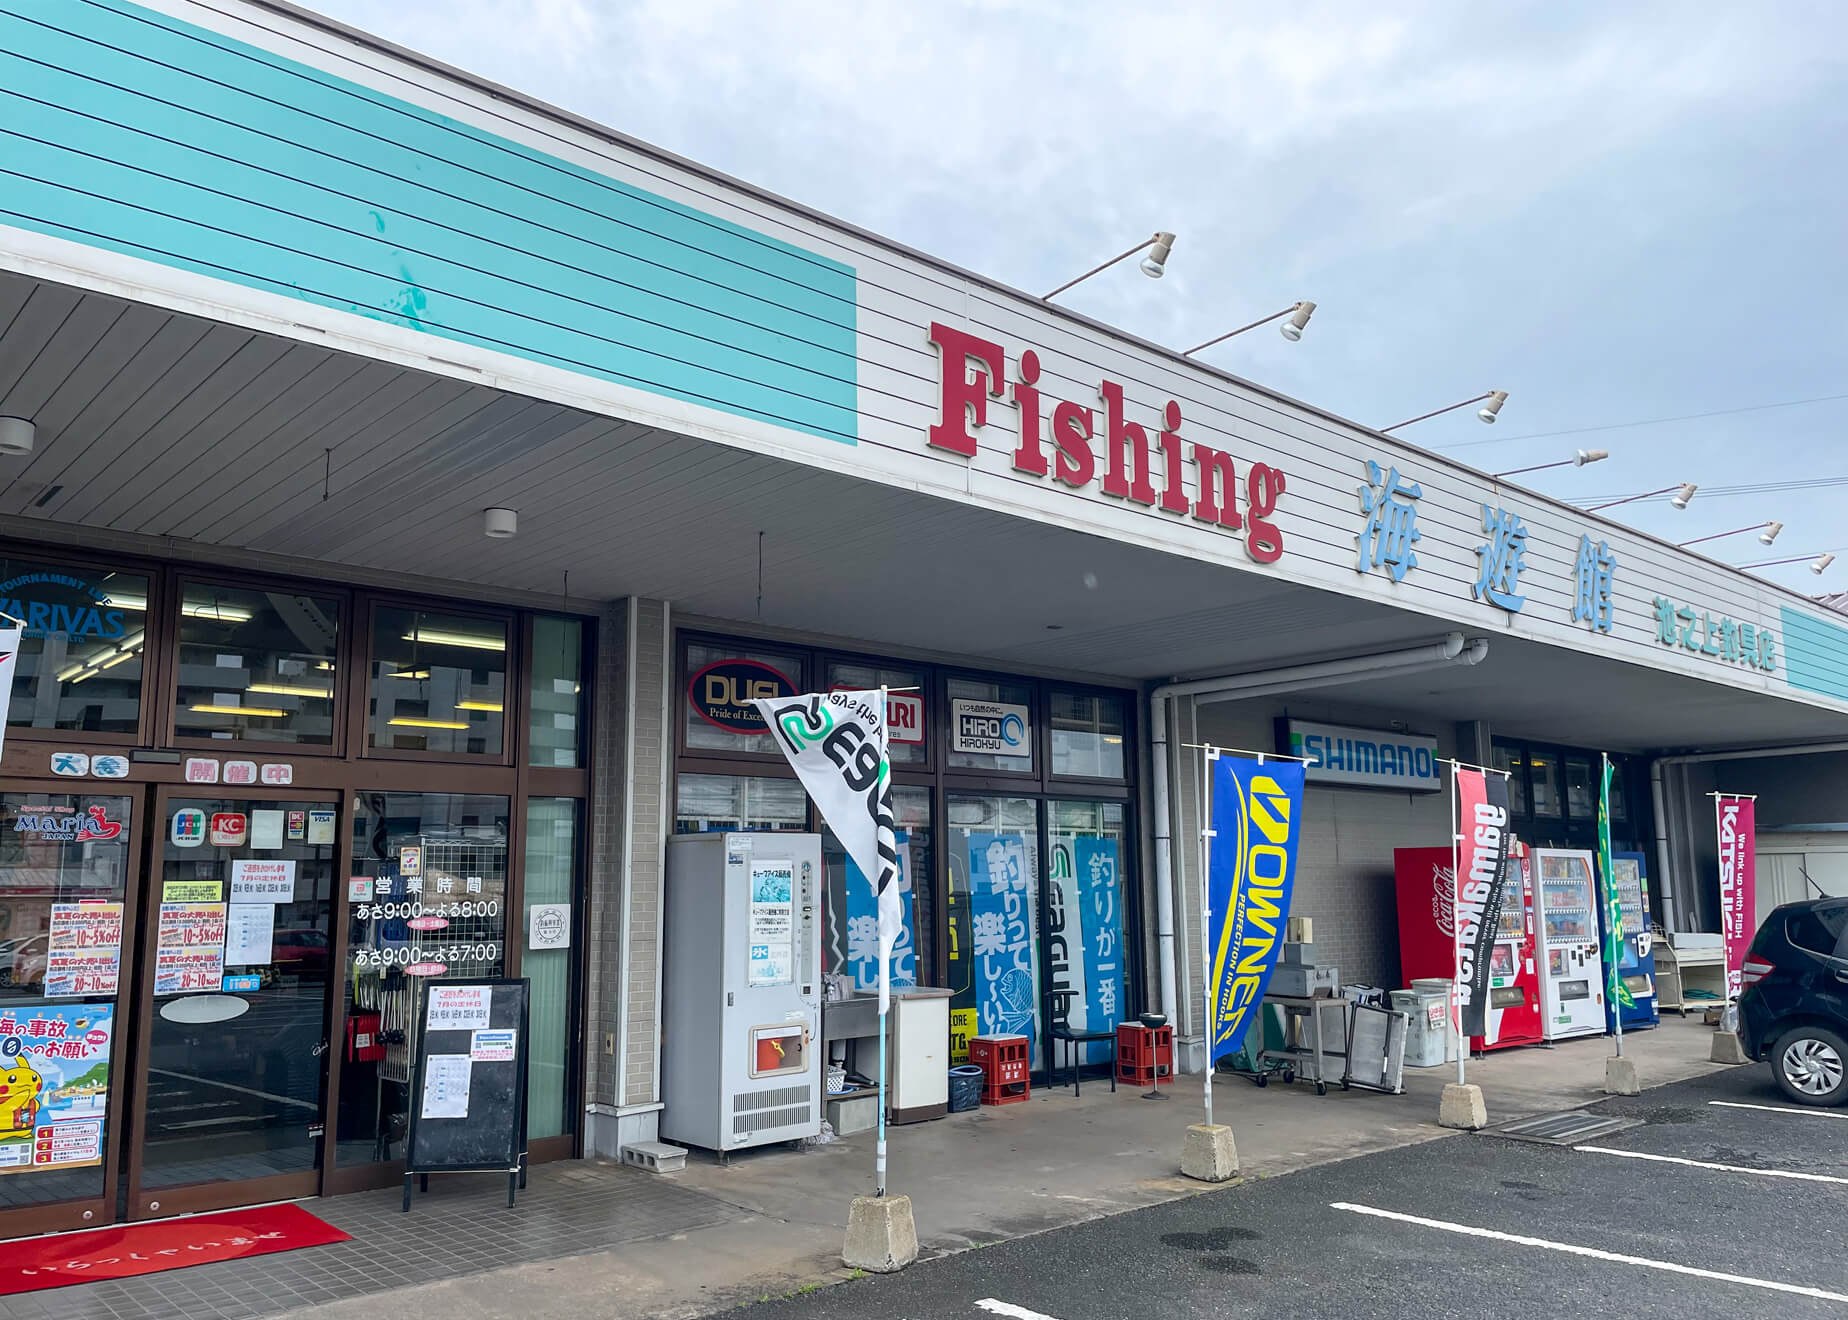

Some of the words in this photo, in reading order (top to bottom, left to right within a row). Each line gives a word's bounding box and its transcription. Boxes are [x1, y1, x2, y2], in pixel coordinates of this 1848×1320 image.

[926, 321, 1285, 563] Fishing
[1355, 460, 1617, 632] 海遊館
[1652, 596, 1776, 671] 池之上釣具店
[710, 708, 731, 719] Pride
[732, 709, 742, 719] of
[962, 717, 1000, 738] HIRO
[960, 738, 1001, 750] HIROKYU
[1304, 734, 1431, 778] SHIMANO
[14, 812, 103, 834] Maria
[218, 819, 240, 831] KC
[42, 832, 75, 841] JAPAN
[1737, 833, 1746, 849] We
[1736, 851, 1746, 870] link
[375, 876, 482, 894] 営業時間
[1735, 873, 1744, 886] up
[986, 840, 1031, 971] 釣りって
[1735, 888, 1745, 911] with
[1228, 893, 1246, 970] PERFECTION
[752, 946, 768, 959] 氷
[1222, 844, 1288, 1041] OWNER
[1225, 971, 1236, 986] IN
[1216, 988, 1231, 1030] HOOKS
